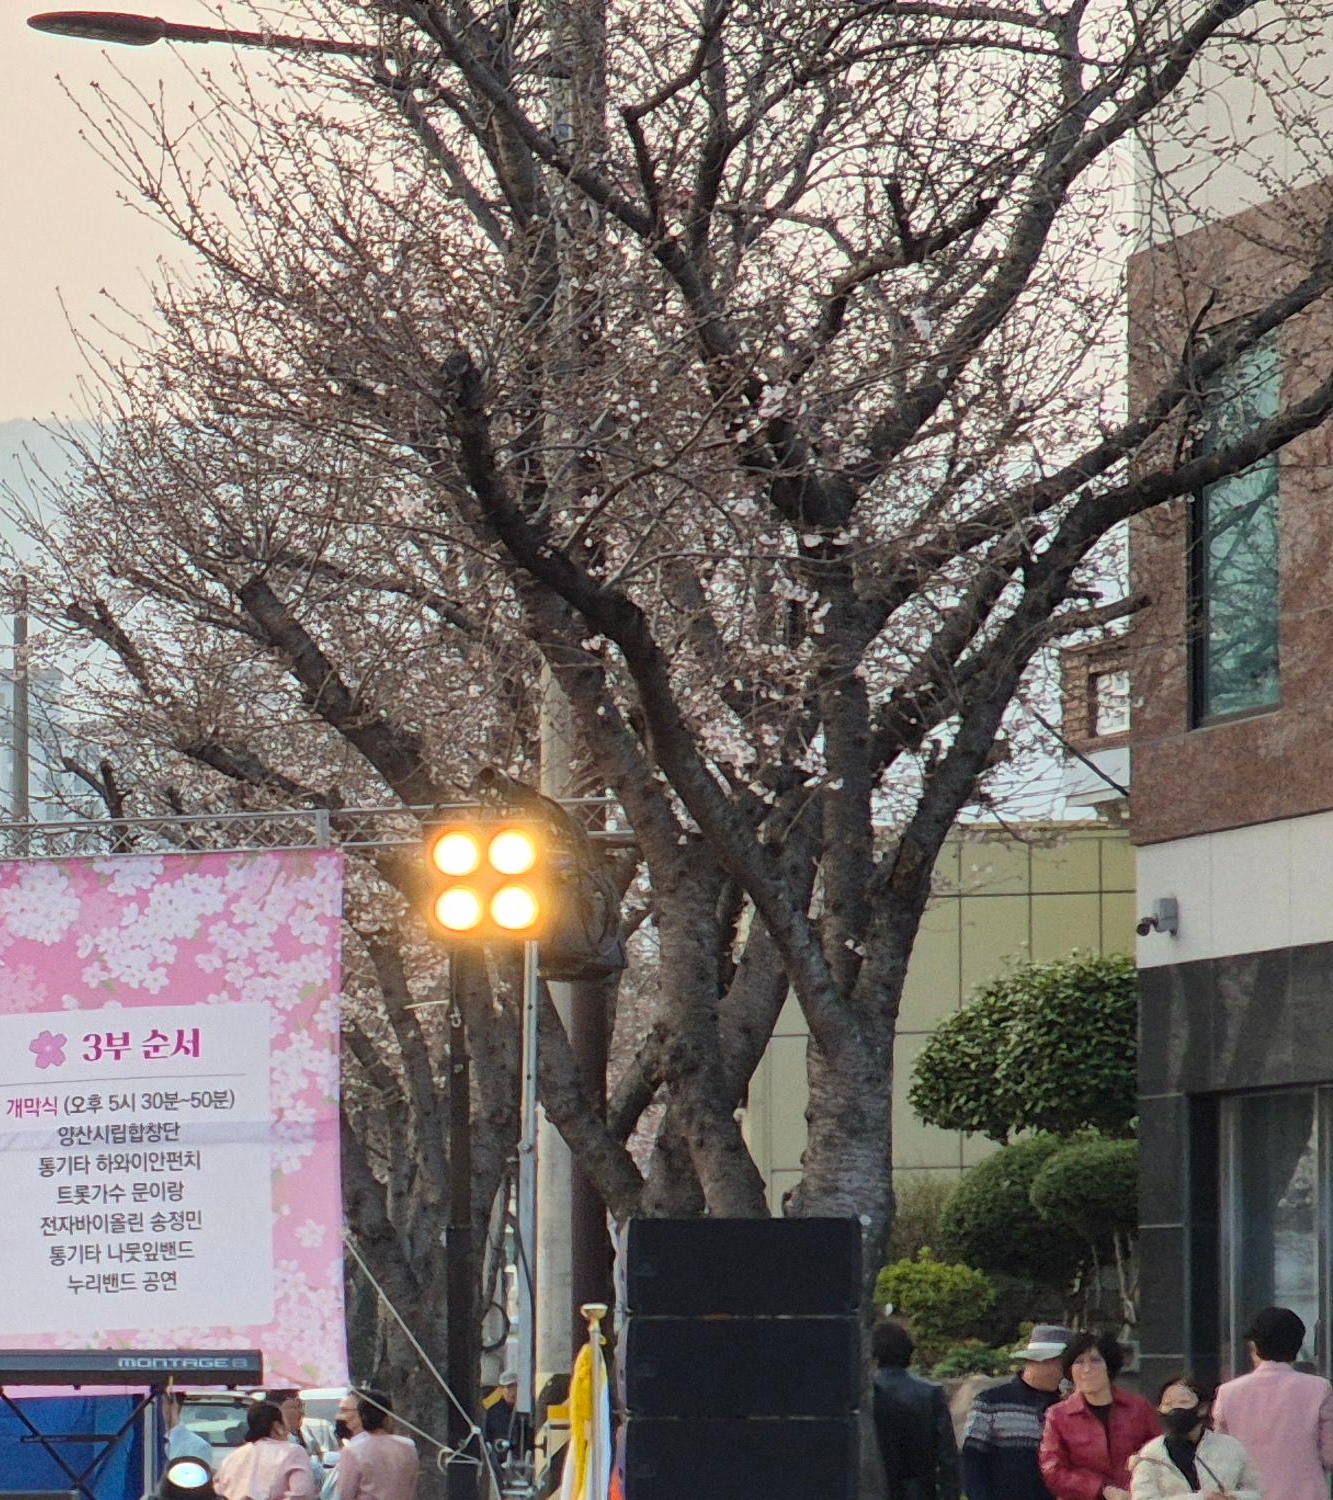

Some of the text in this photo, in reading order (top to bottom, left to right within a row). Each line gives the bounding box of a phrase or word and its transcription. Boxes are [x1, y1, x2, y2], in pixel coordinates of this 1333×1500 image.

[82, 1028, 200, 1062] 3부 순서
[6, 1089, 235, 1118] 개막식 (오후 5시 30분~50분)
[57, 1121, 181, 1146] 양산시립합창단
[38, 1150, 202, 1178] 통기타 하와이안펀치
[56, 1181, 185, 1205] 트롯가수 문이랑
[40, 1210, 202, 1237] 전자바이올린 송정민
[49, 1240, 195, 1266] 통기타 나뭇잎밴드
[67, 1270, 178, 1295] 누리밴드 공연
